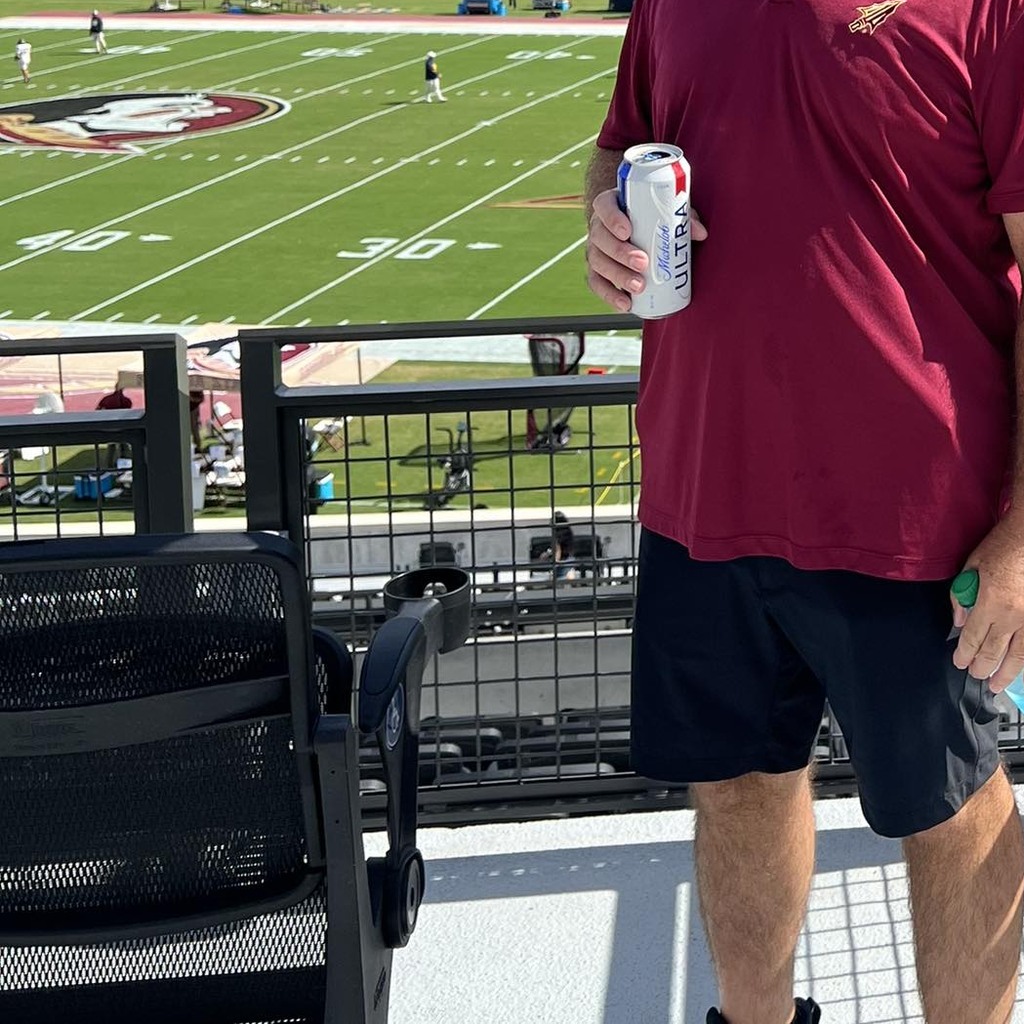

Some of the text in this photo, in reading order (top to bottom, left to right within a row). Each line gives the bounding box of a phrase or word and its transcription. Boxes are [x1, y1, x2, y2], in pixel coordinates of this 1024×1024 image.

[16, 229, 132, 253] 40
[336, 237, 457, 260] 30
[657, 224, 672, 282] Michelob
[674, 201, 689, 291] ULTRA
